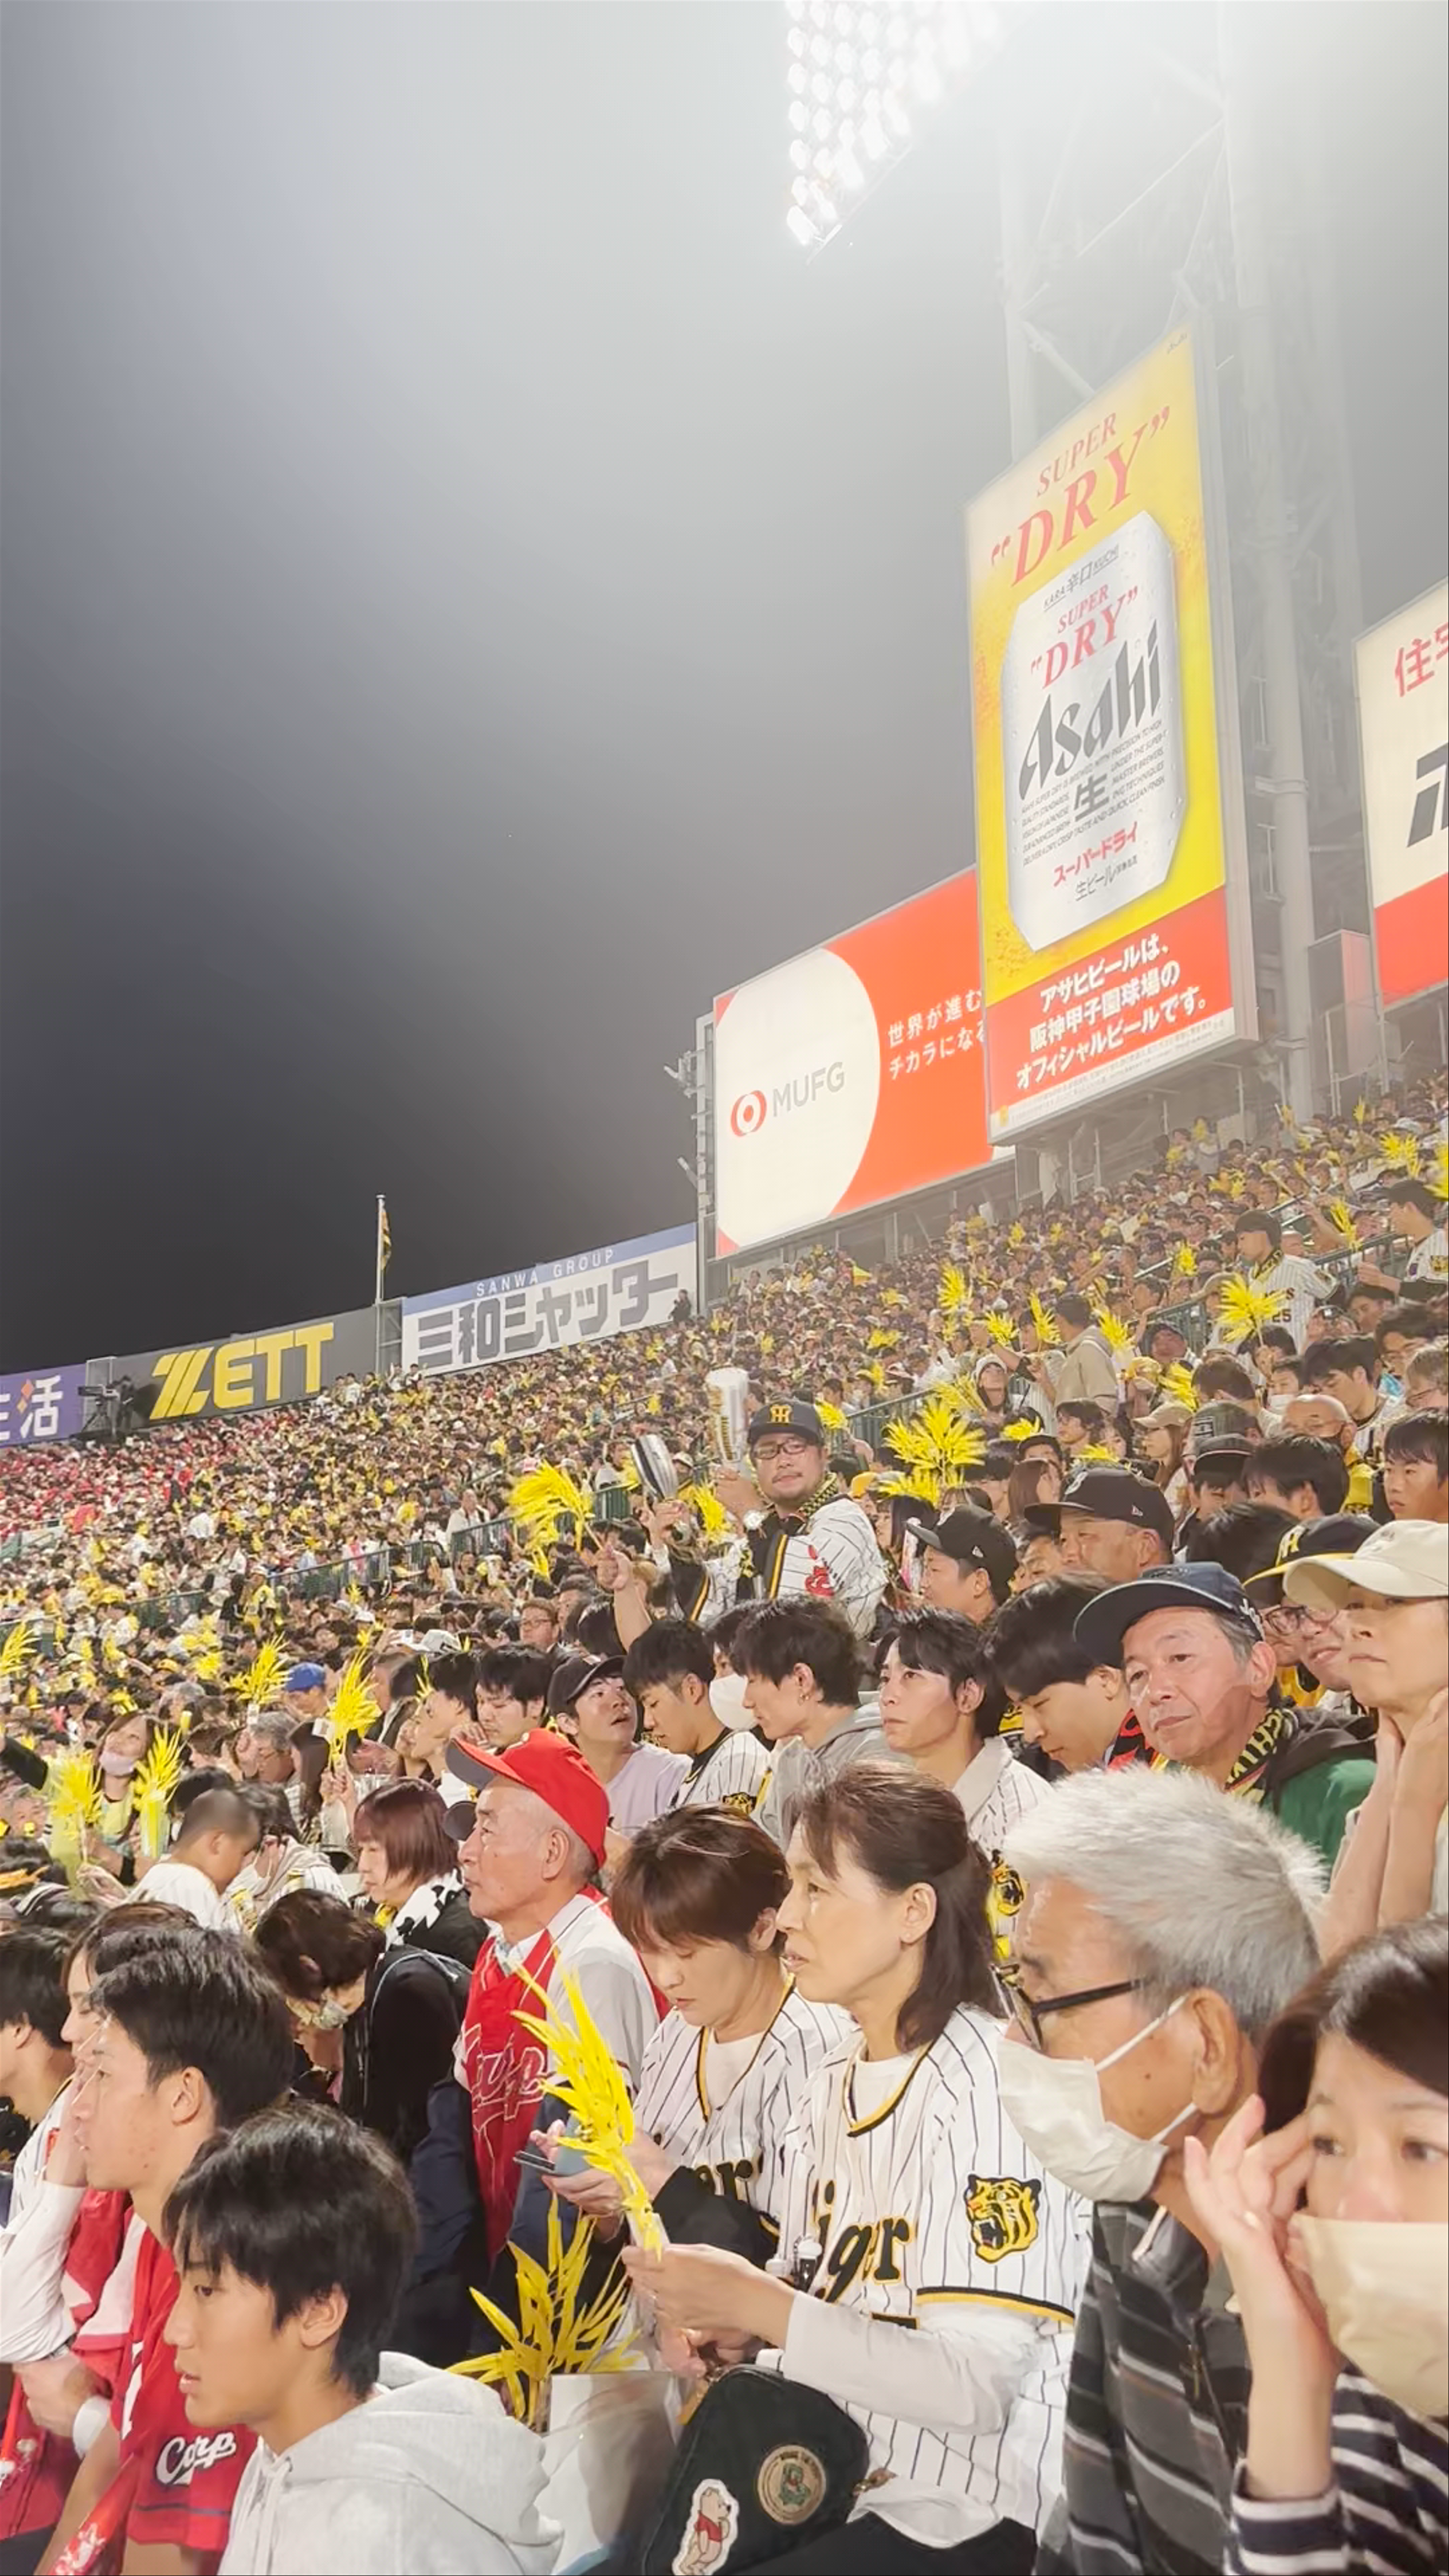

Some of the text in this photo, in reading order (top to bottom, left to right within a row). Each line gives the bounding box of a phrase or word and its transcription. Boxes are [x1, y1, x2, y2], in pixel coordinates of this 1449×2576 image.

[1036, 412, 1117, 497] SUPER
[1057, 584, 1109, 634] SUPER
[1066, 561, 1093, 593] 辛口
[1019, 619, 1161, 801] Asahi
[1074, 774, 1109, 822] 生
[1053, 821, 1137, 887] スーパードライ
[1040, 933, 1169, 1012] アサヒビールは、
[1016, 986, 1205, 1089] オフィシャルビールです。
[1029, 961, 1180, 1052] 阪神甲子園球場の
[773, 1061, 845, 1117] MUFG
[476, 1249, 614, 1297] SANWA GROUP
[418, 1260, 678, 1368] 三和シャッター
[150, 1322, 334, 1420] ZETT
[0, 1375, 63, 1437] 活
[155, 2431, 237, 2485] Carp
